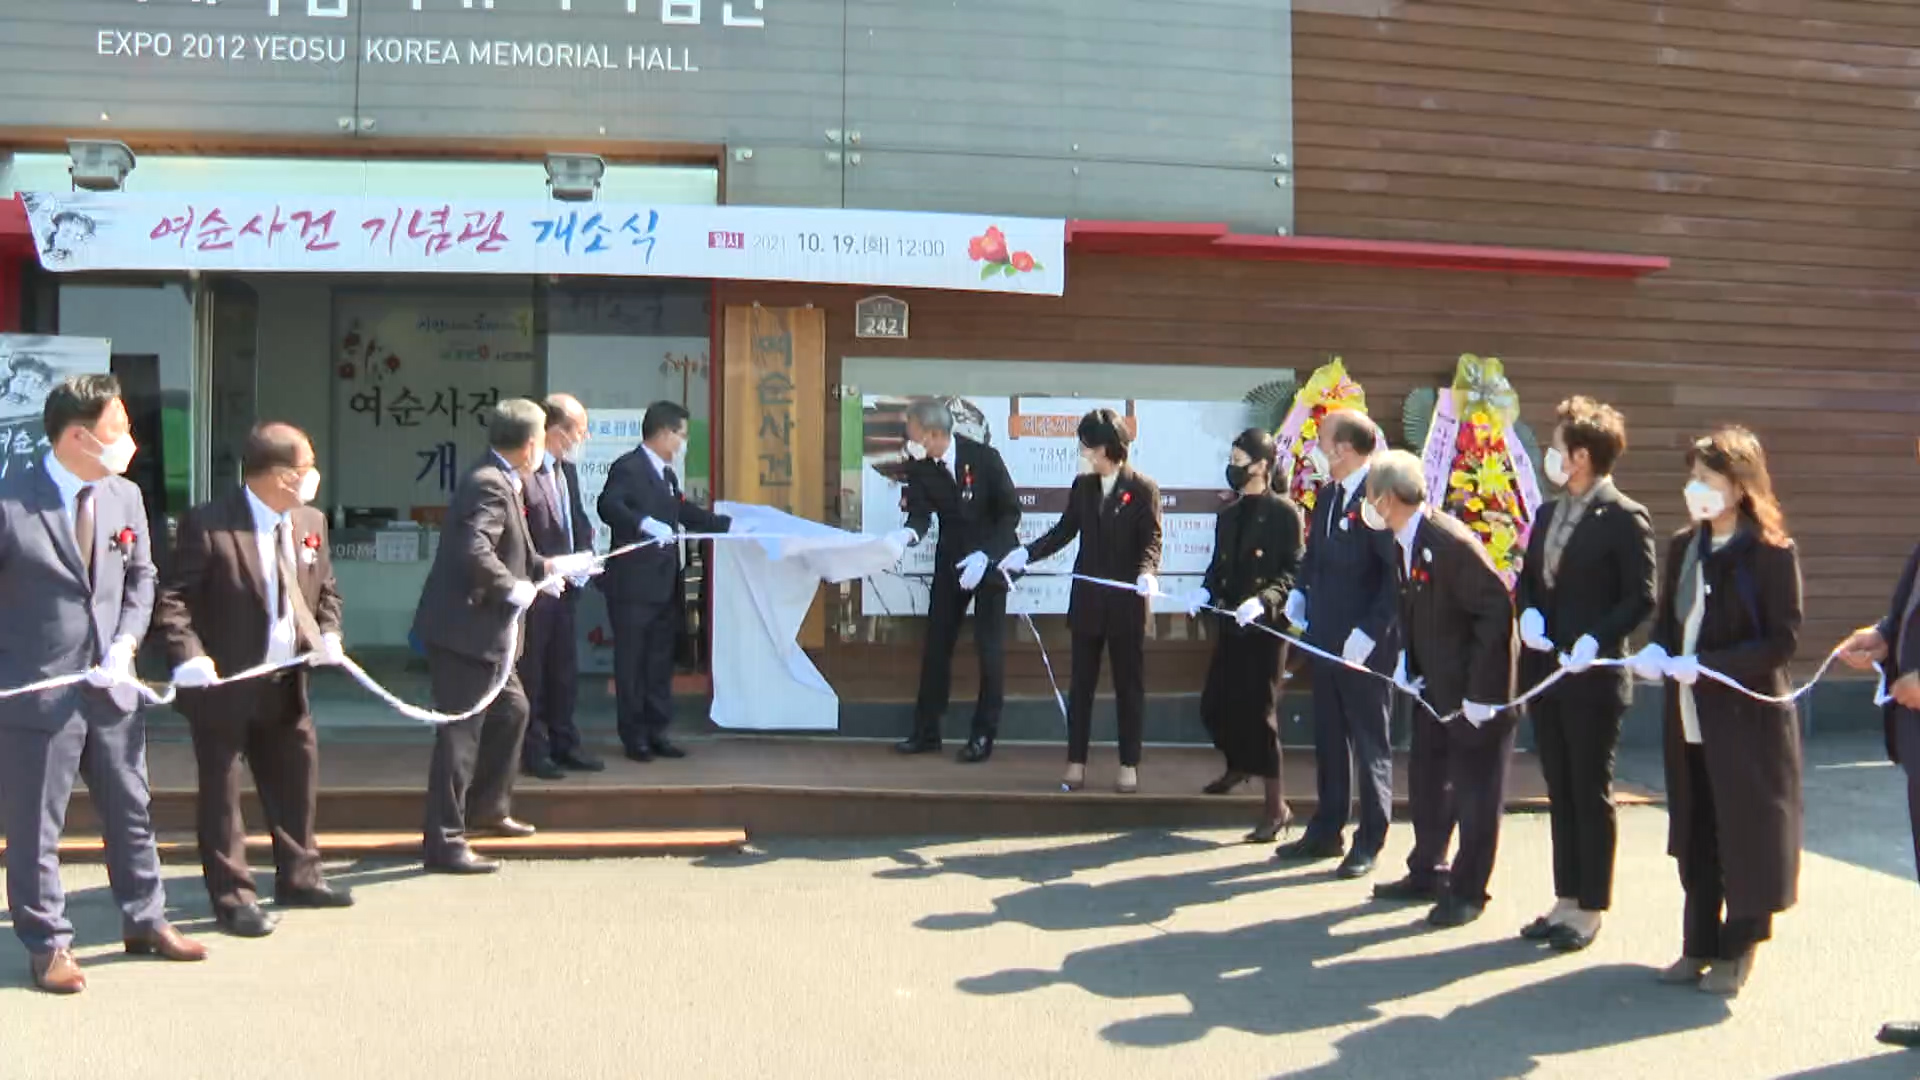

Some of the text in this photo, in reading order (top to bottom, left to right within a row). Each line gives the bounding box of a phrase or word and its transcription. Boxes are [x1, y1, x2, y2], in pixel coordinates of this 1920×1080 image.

[97, 30, 699, 71] EXPO 2012 YEOSU KOREA MEMORIAL HALL
[150, 204, 660, 265] 여순사건 기념관 개소식
[798, 232, 825, 253] 10.
[897, 239, 945, 257] 12:00
[865, 317, 898, 335] 242
[757, 331, 795, 487] 여순사건
